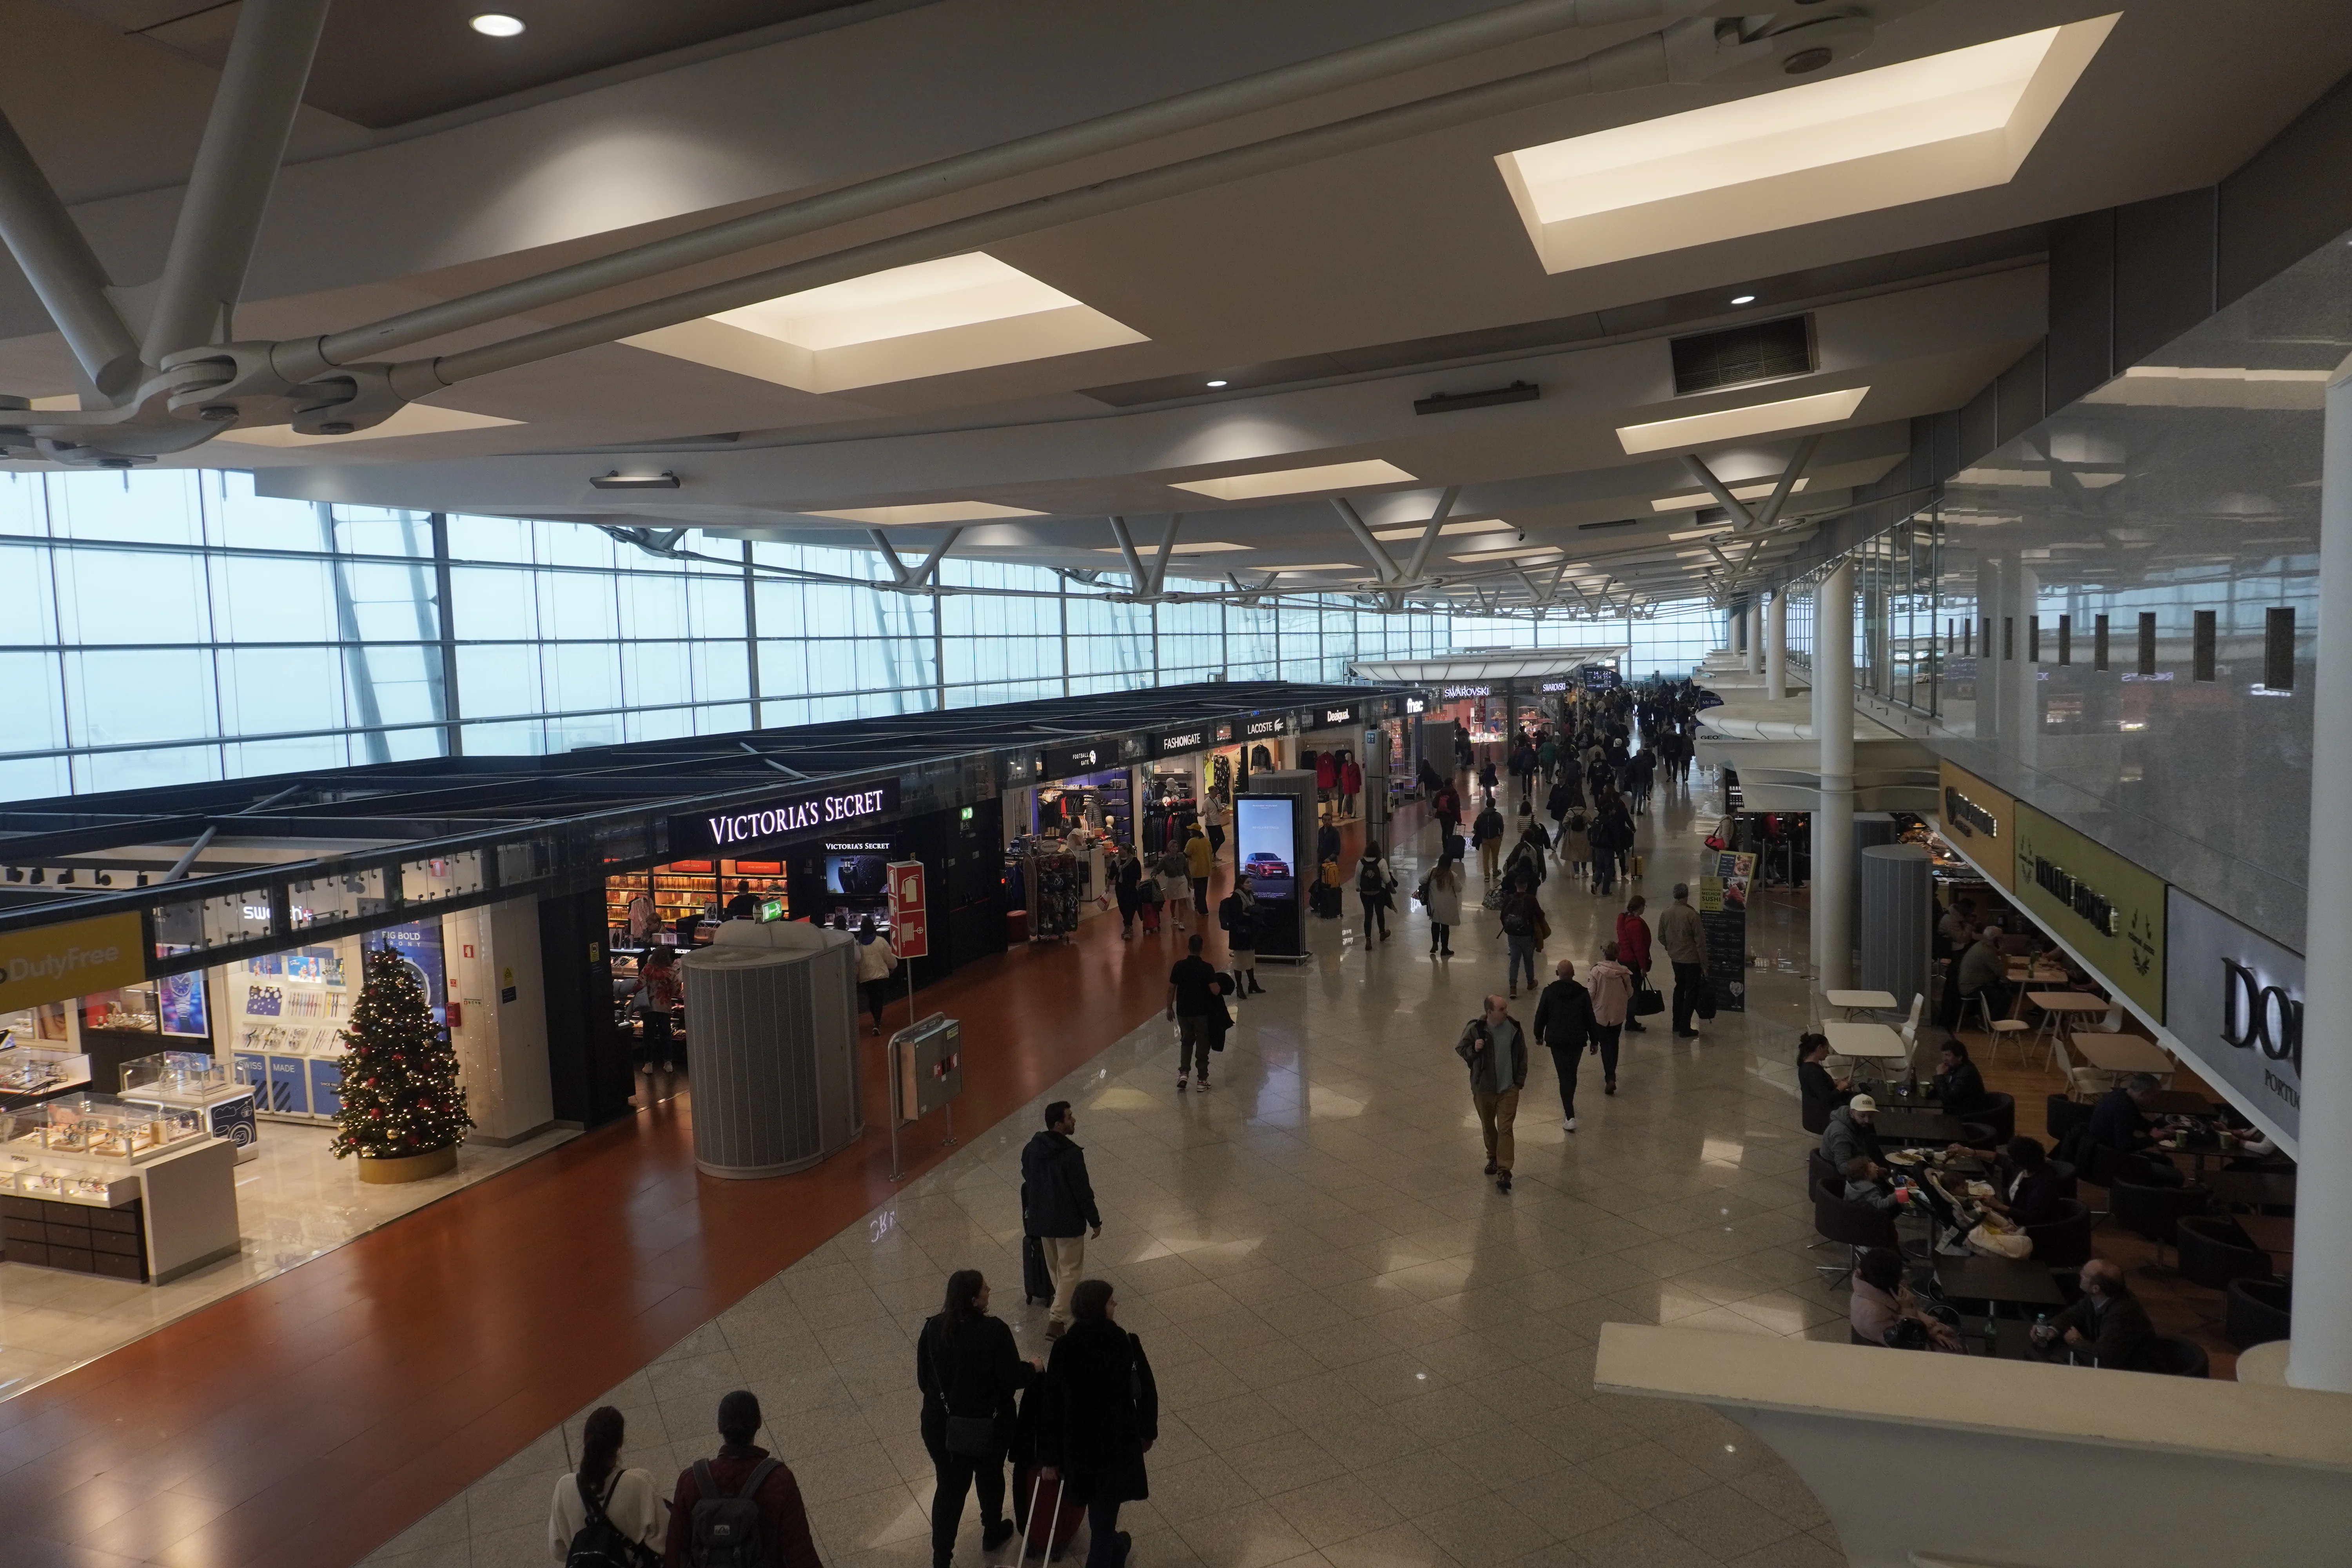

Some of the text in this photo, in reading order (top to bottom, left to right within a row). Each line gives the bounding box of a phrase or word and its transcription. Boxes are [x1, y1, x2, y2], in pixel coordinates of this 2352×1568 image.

[1445, 687, 1489, 697] SWAROVSKI
[1543, 683, 1566, 691] SWAROVSKI
[1407, 698, 1423, 713] fnac
[1247, 722, 1272, 735] LACOSTE
[1164, 733, 1201, 750] FASHIONGATE
[709, 790, 883, 844] VICTORIA'S SECRET
[398, 932, 420, 940] BOLD
[9, 946, 119, 981] DutyFree
[238, 1062, 295, 1073] SWISS MADE
